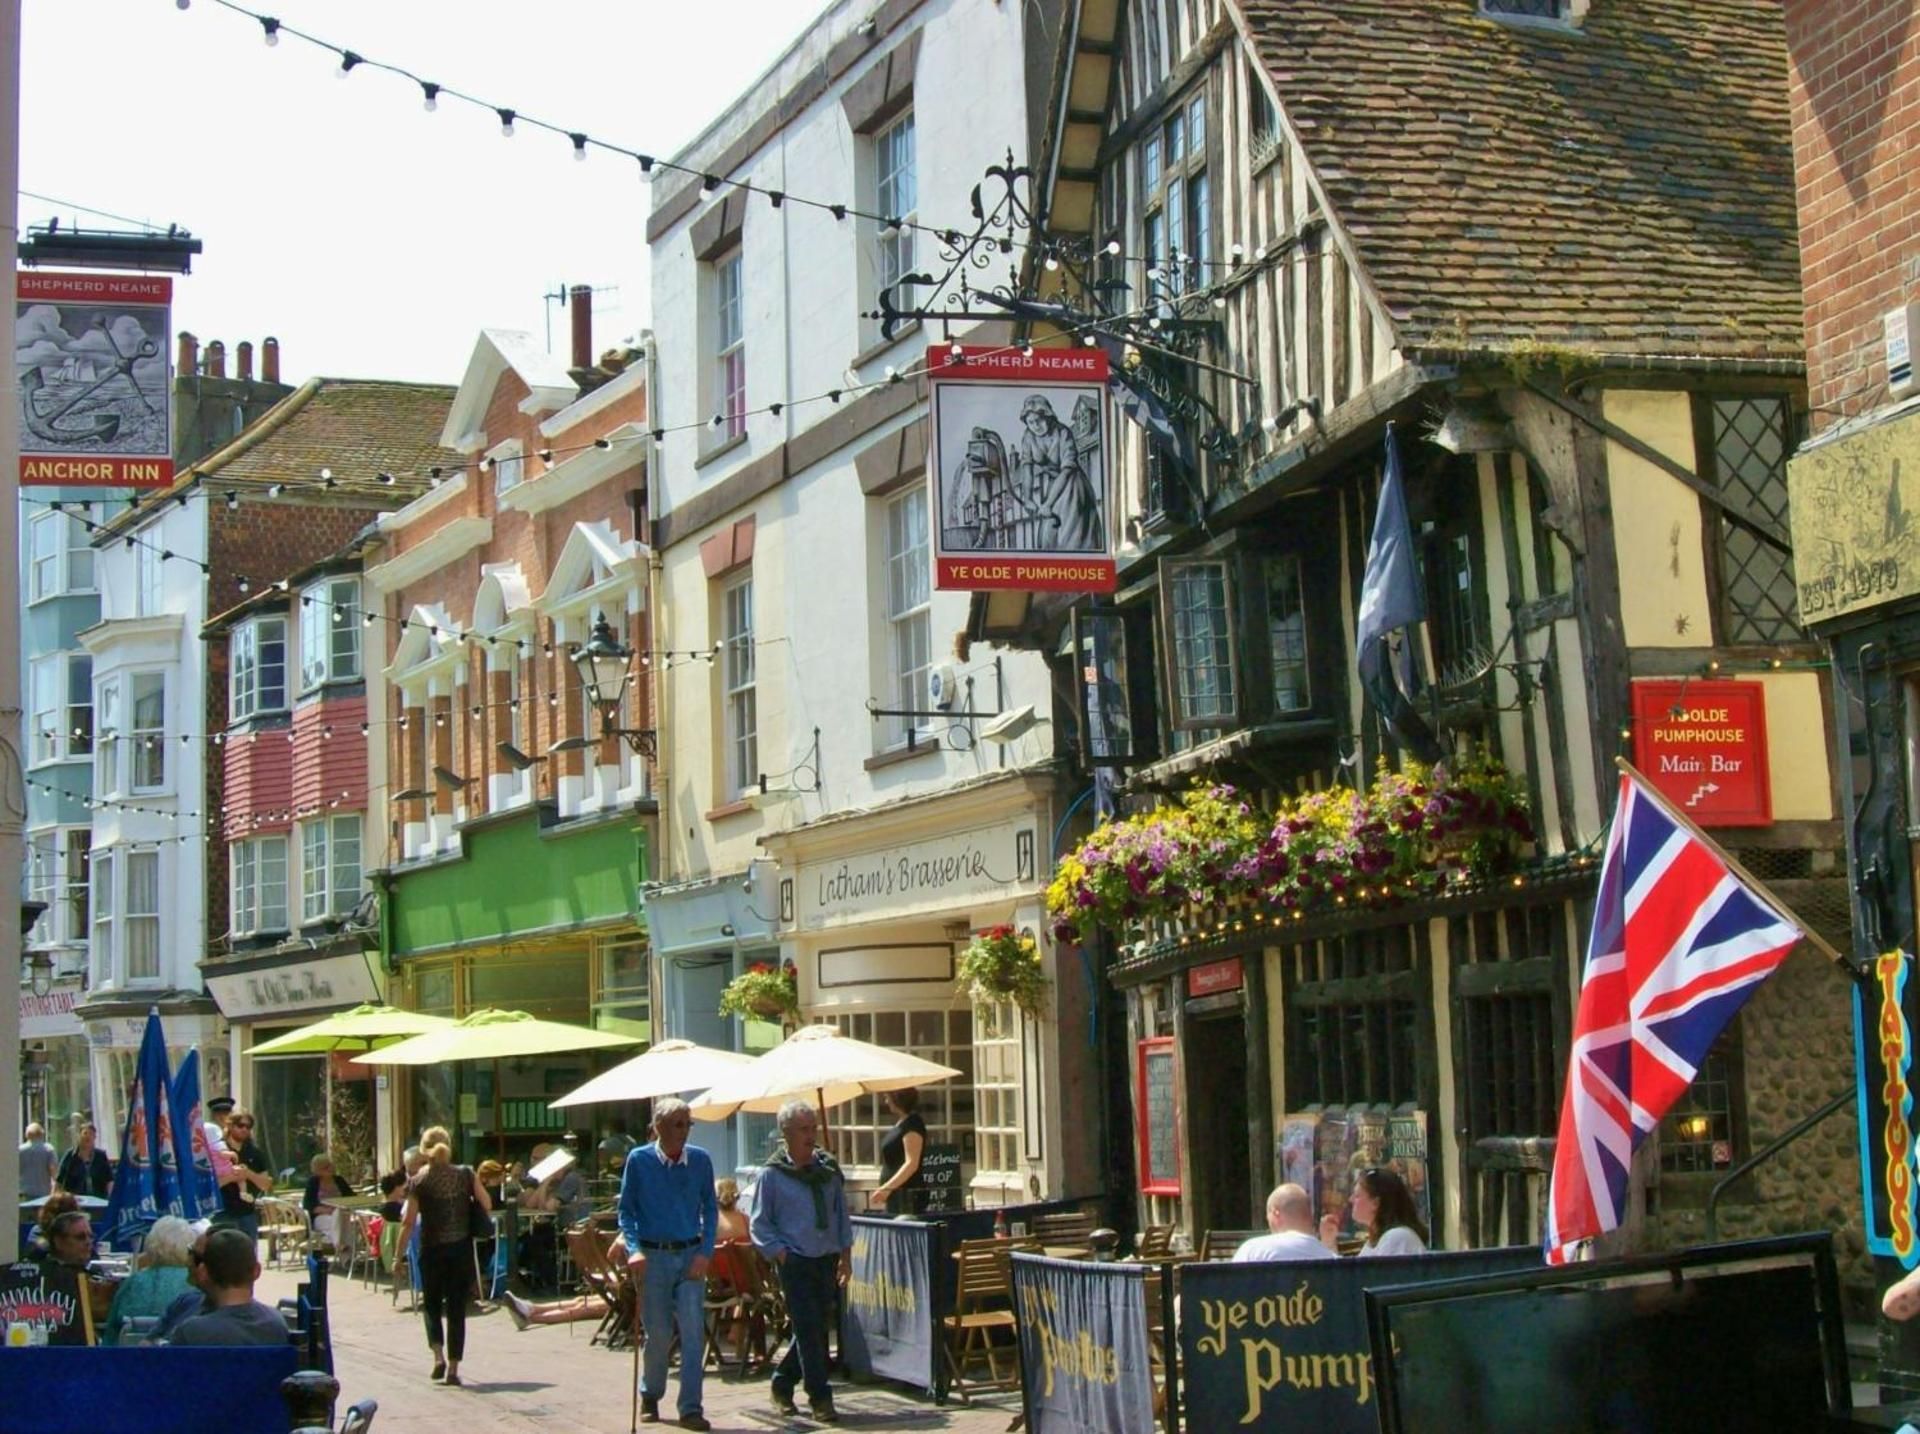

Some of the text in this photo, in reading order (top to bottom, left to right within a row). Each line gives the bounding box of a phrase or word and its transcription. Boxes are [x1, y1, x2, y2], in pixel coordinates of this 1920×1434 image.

[21, 279, 161, 295] SHEPHERD NEAME
[943, 355, 1096, 370] SEPHERD NEAME
[24, 461, 160, 481] ANCHOR INN
[949, 566, 1107, 581] YE OLDE PUMPHOUSE
[1690, 708, 1729, 722] OLDE
[1653, 729, 1745, 743] PUMPHOUSE
[1710, 754, 1742, 773] Bar
[818, 857, 895, 906] Latham's
[1877, 951, 1913, 1253] TATTOOS
[0, 1275, 77, 1326] unday
